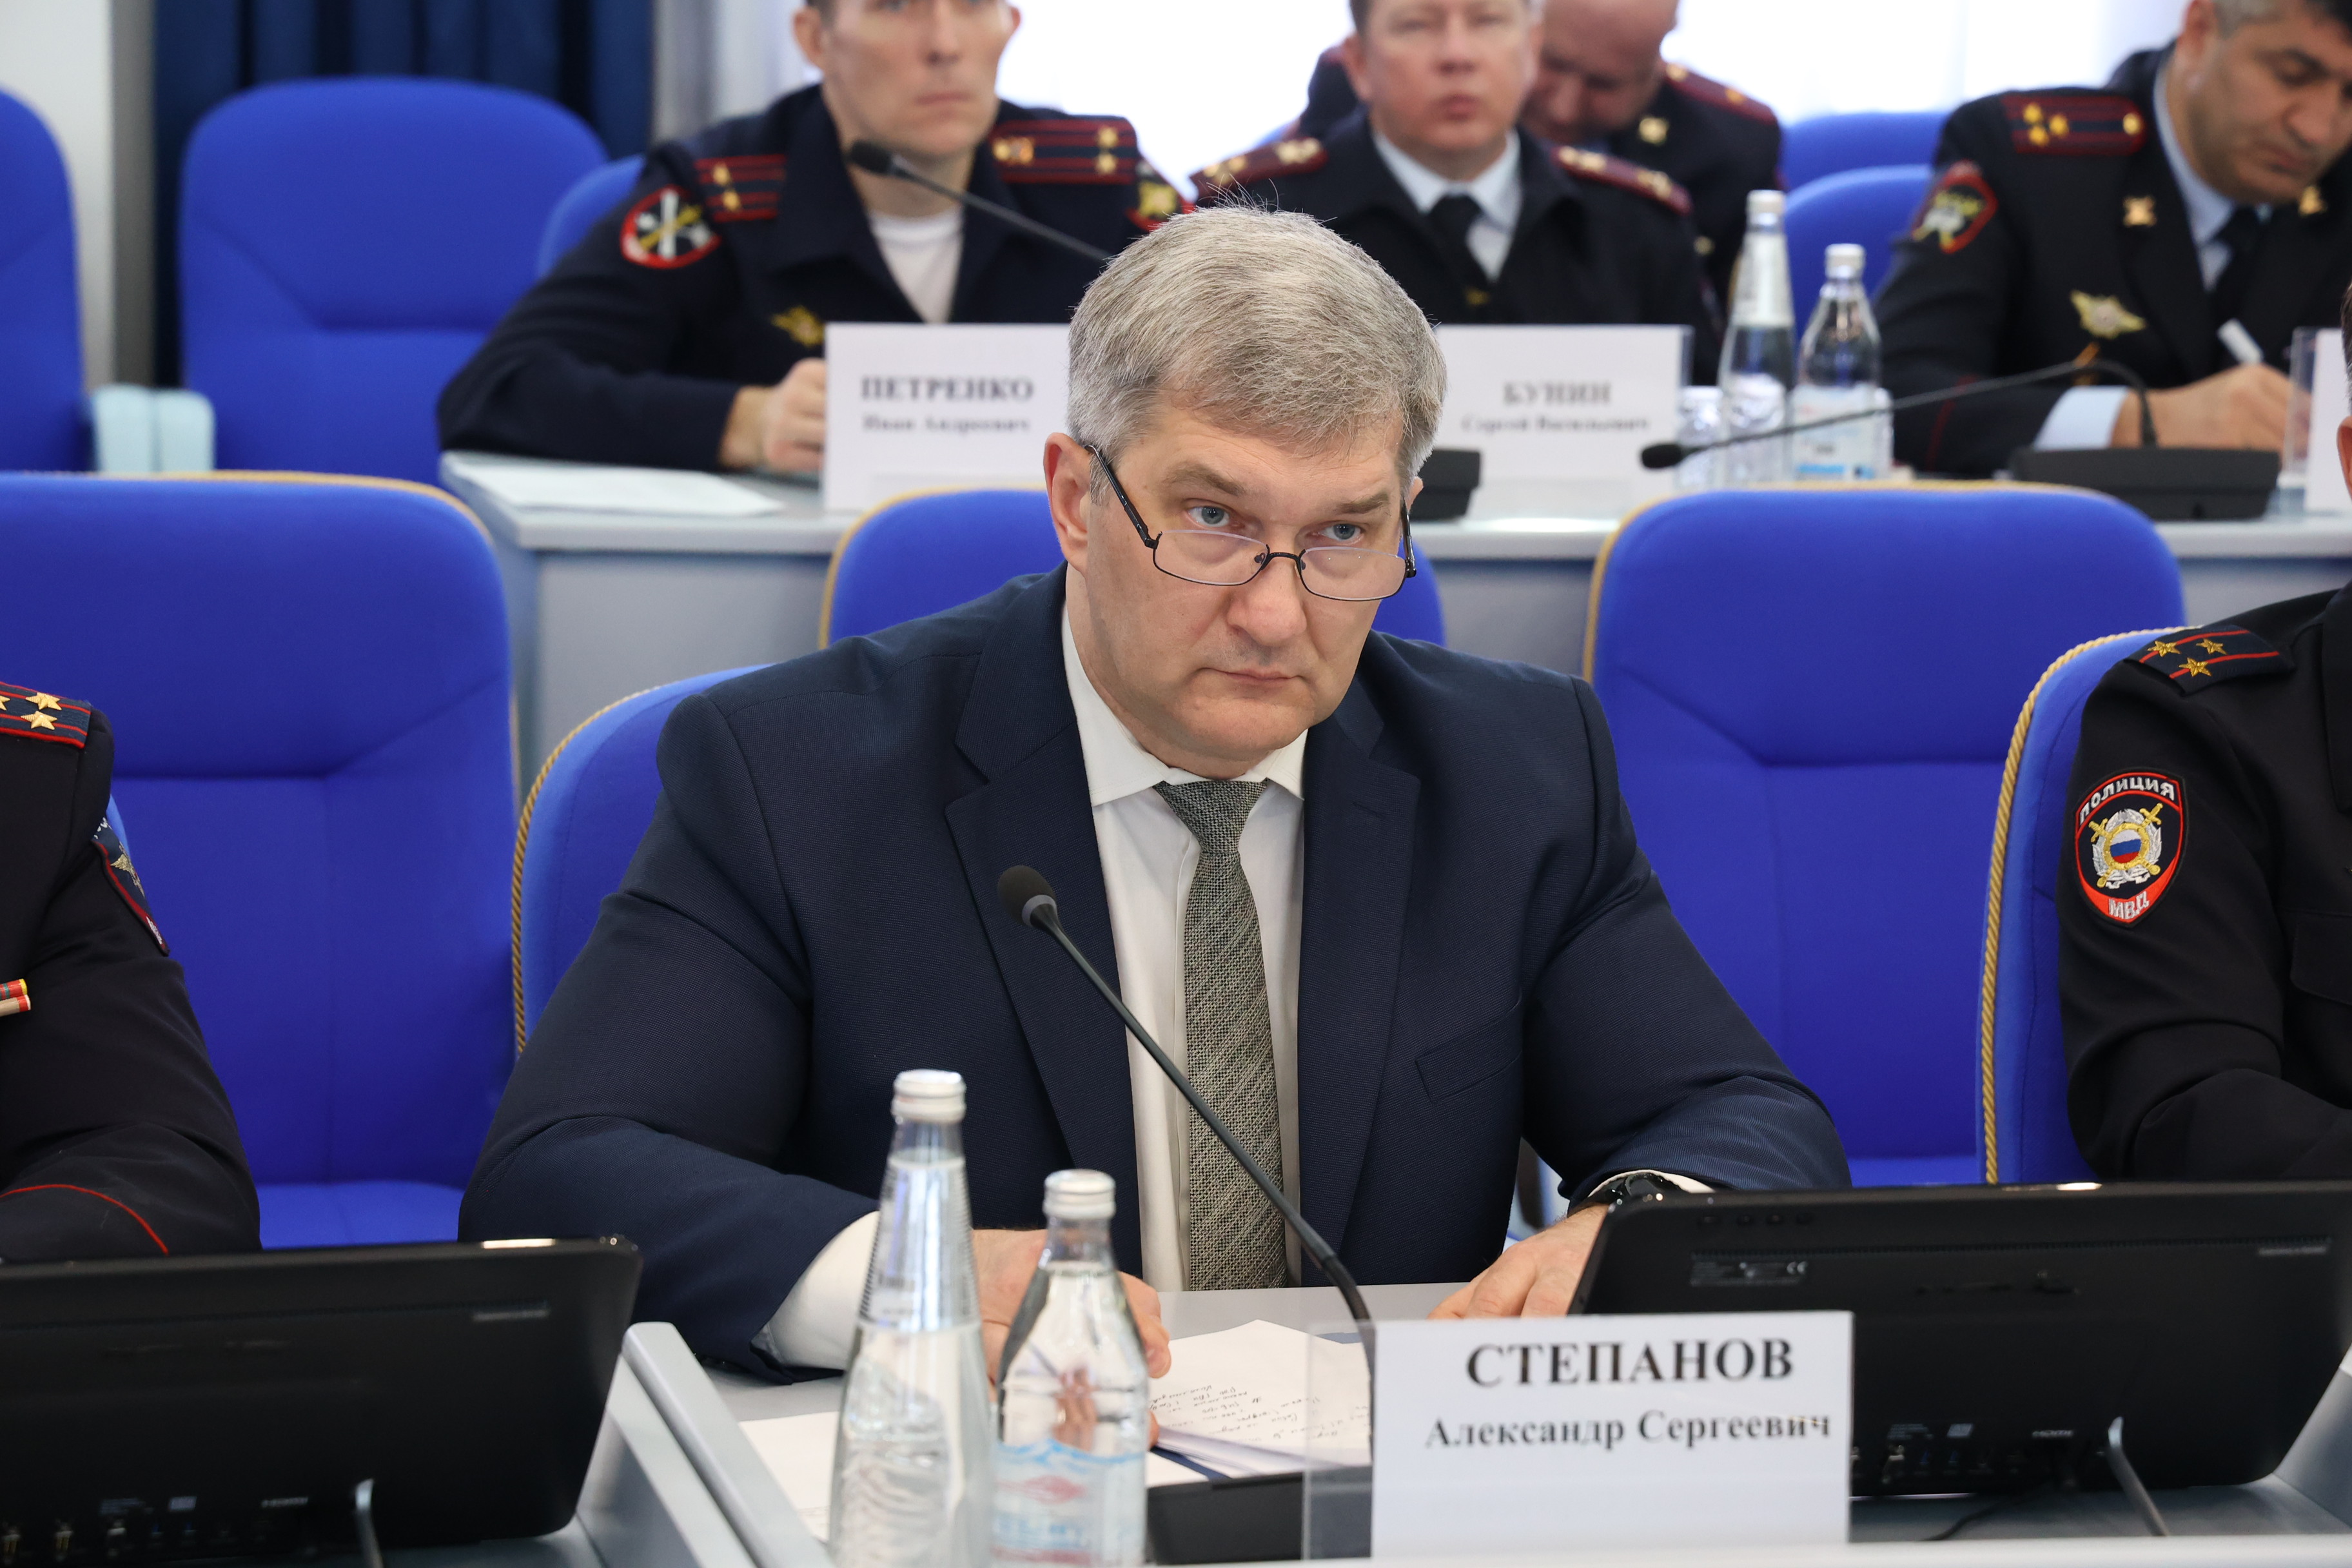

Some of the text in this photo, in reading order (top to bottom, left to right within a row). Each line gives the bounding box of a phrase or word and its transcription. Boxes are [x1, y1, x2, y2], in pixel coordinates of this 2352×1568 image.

[861, 375, 1034, 400] ПЕТРЕНКО
[2080, 776, 2175, 825] ПОЛИЦИЯ
[2108, 891, 2150, 919] МВД
[1466, 1337, 1794, 1387] СТЕПАНОВ
[1425, 1409, 1830, 1451] Александр Сергеевич
